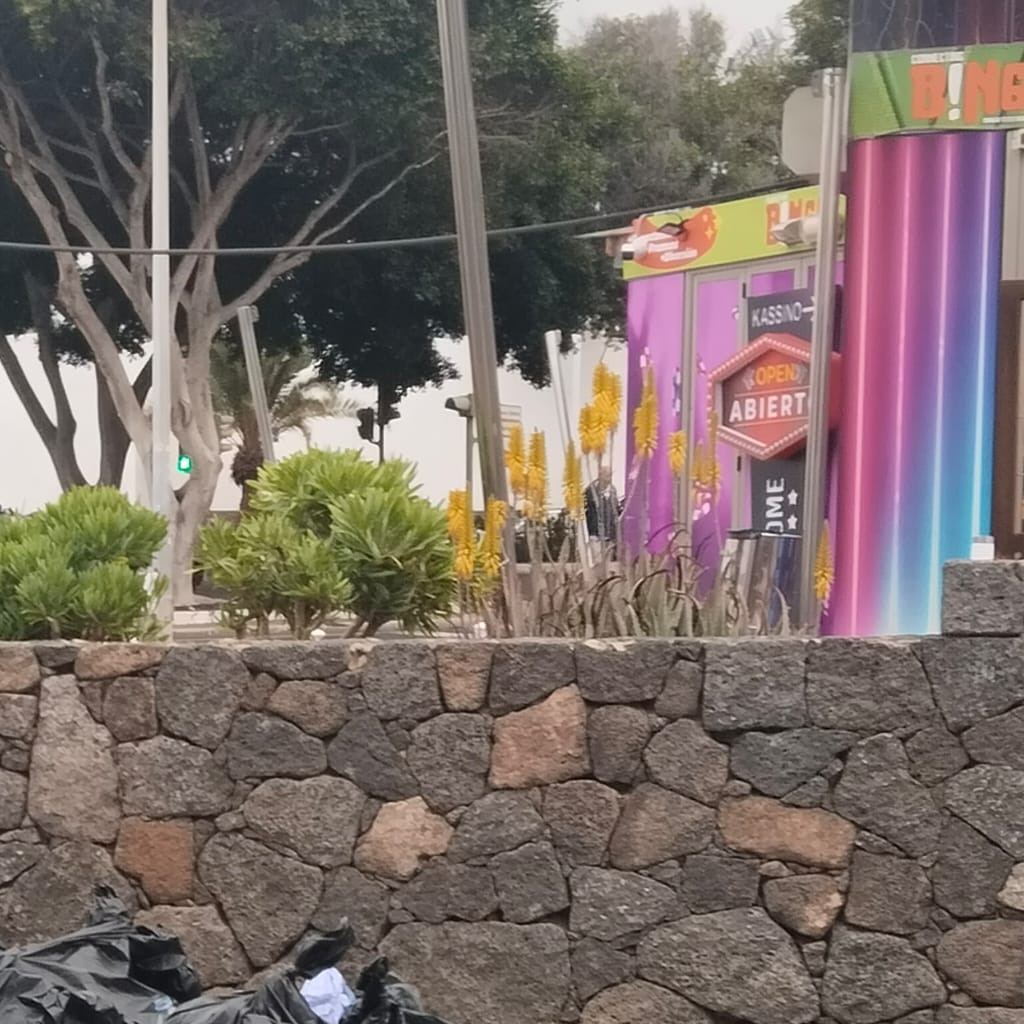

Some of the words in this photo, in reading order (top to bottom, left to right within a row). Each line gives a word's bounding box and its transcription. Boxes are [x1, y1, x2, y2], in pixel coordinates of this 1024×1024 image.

[751, 301, 803, 328] KASSINO
[755, 364, 798, 386] OPEN
[729, 391, 811, 423] ABIERT
